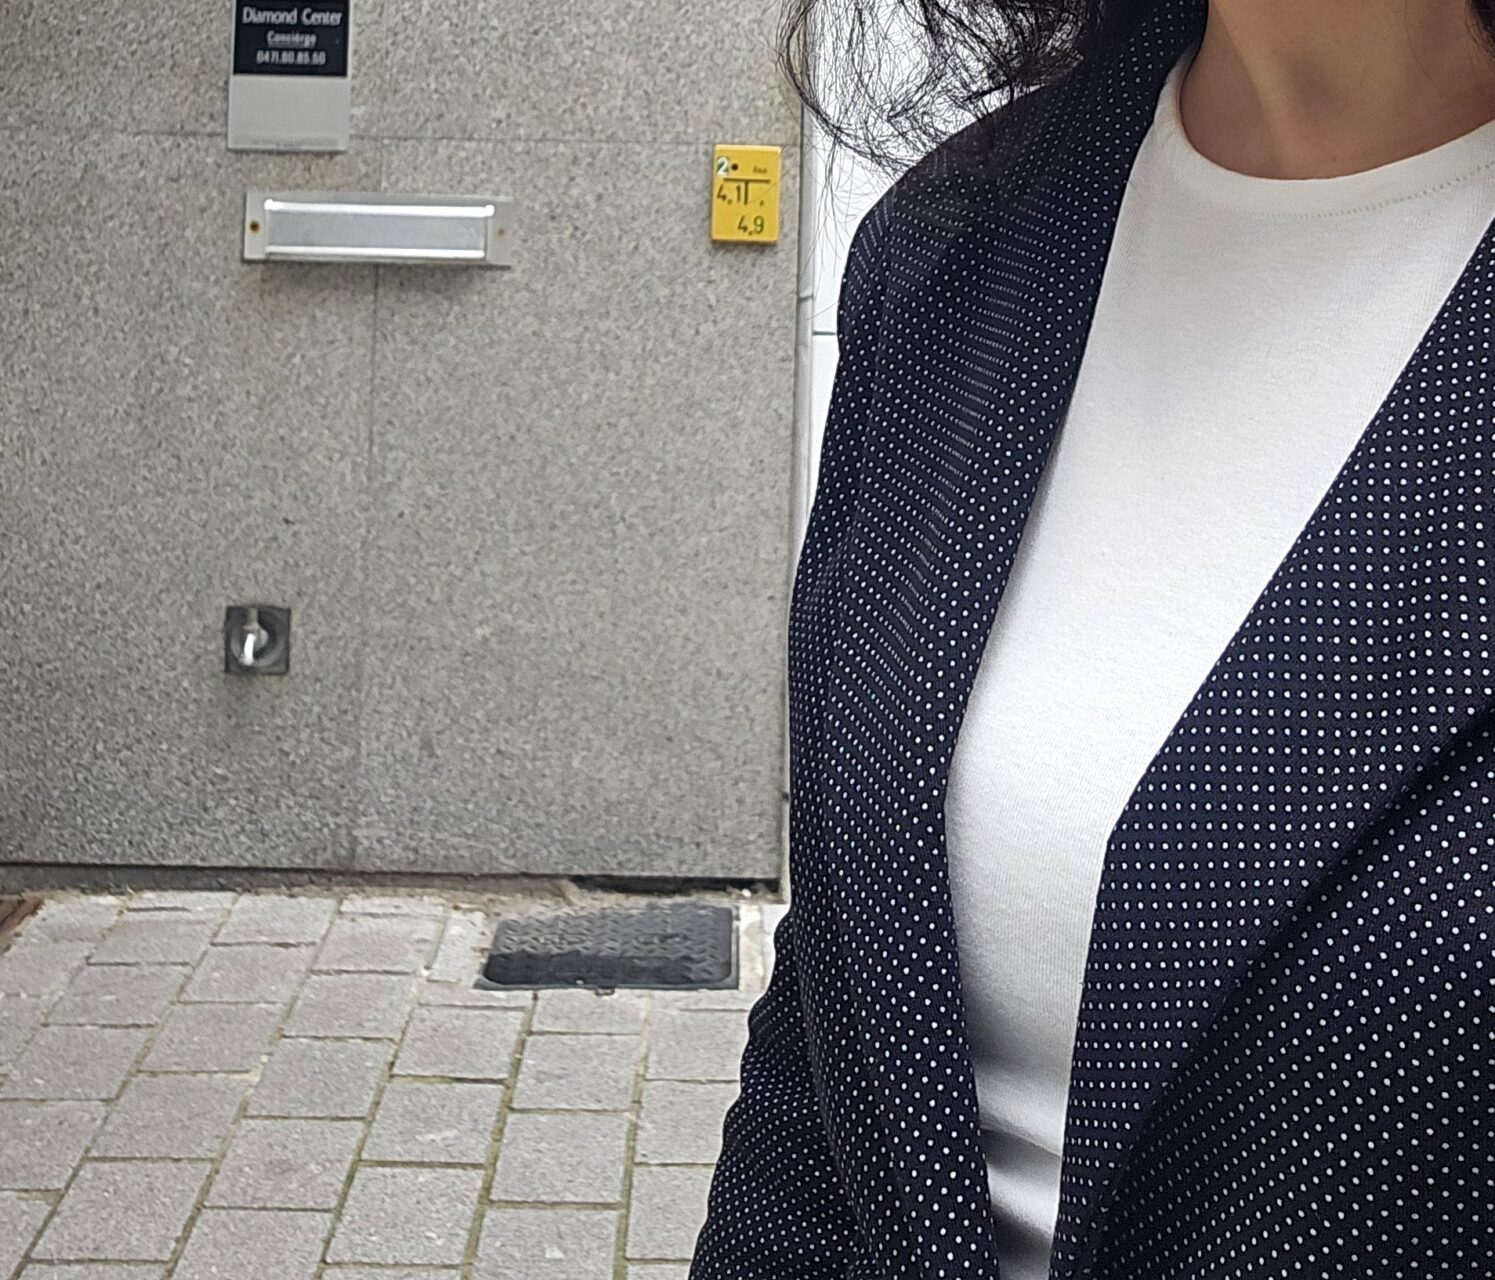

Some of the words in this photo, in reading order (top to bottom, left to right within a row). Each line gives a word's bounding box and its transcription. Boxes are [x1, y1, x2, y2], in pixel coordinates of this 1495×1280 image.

[242, 6, 298, 25] Diamond
[301, 7, 342, 26] Center
[717, 157, 729, 177] 2
